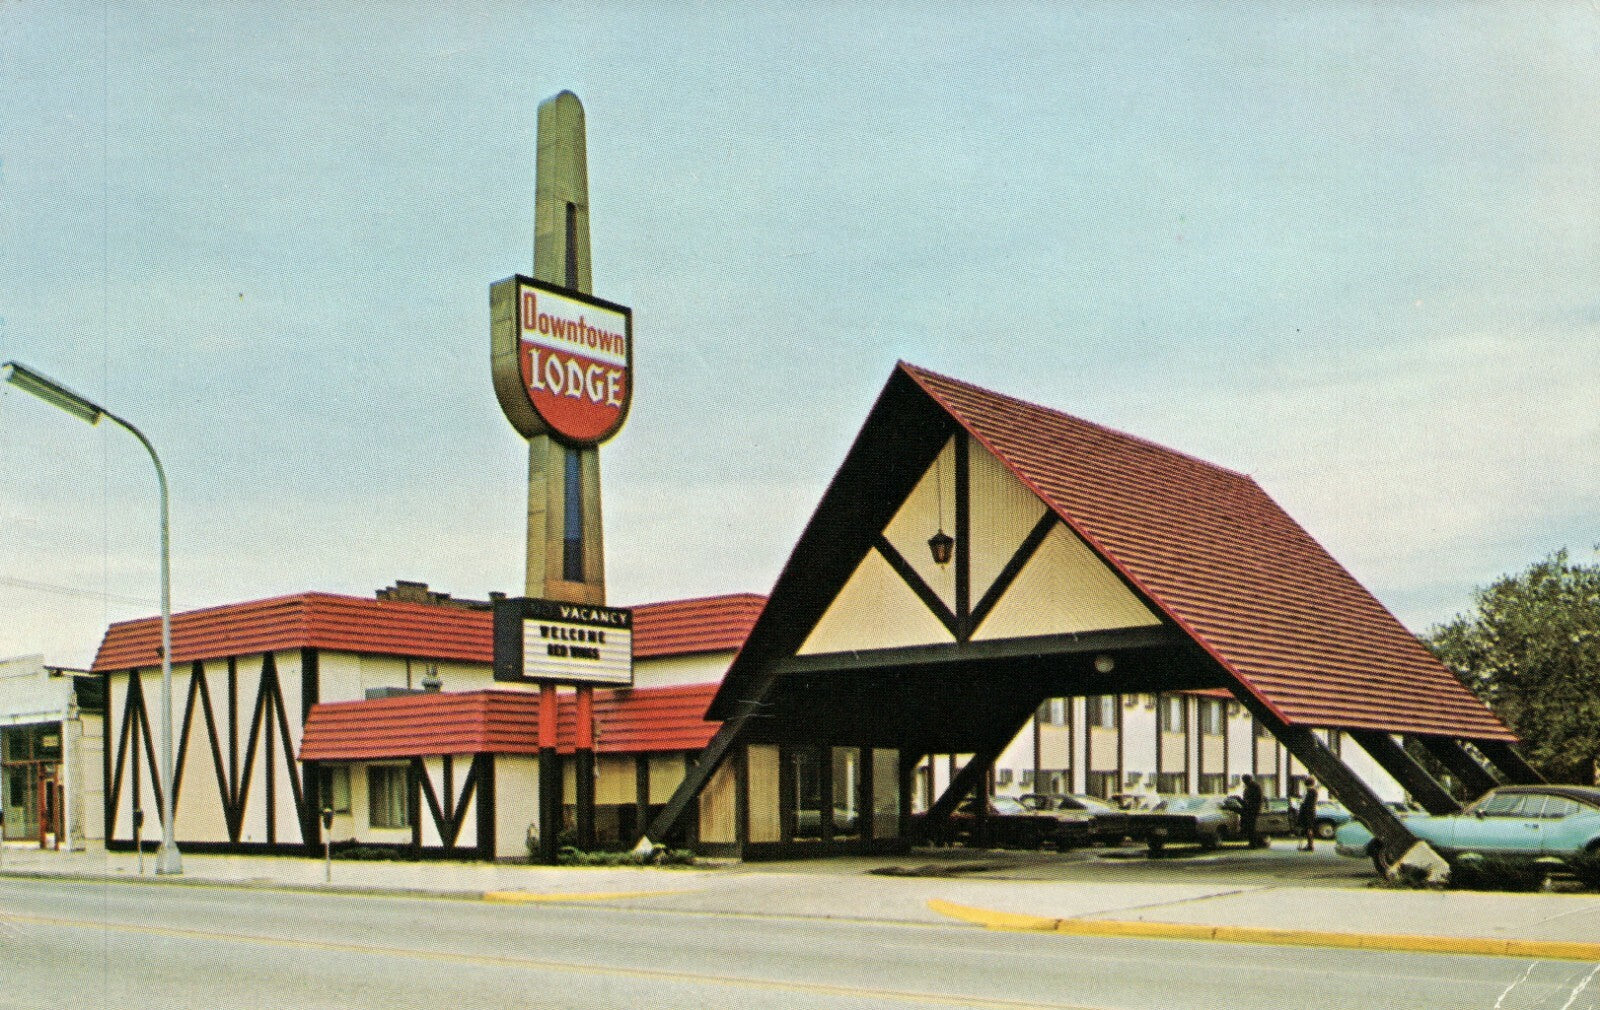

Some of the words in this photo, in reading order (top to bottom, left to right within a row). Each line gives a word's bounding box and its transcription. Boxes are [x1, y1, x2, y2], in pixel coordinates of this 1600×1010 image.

[523, 291, 625, 356] Downtown
[528, 348, 623, 408] LODGE
[560, 606, 627, 624] VACANCY
